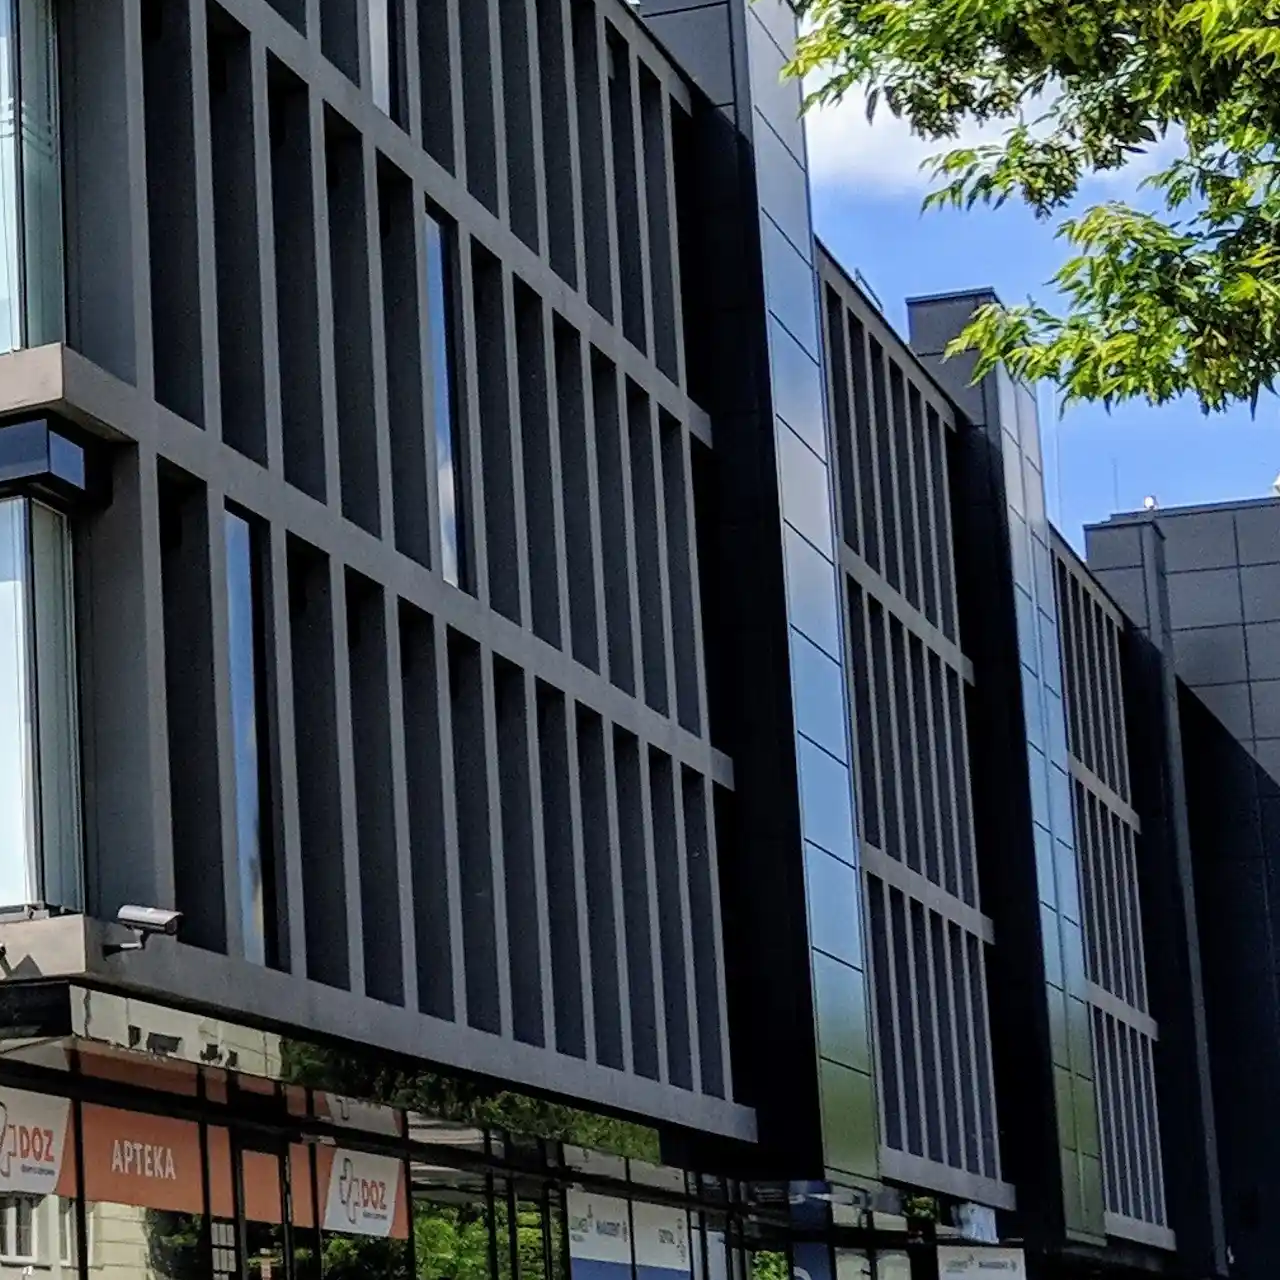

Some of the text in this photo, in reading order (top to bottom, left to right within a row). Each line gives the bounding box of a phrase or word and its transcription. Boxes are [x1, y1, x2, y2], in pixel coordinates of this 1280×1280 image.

[19, 1125, 54, 1162] DOZ
[111, 1139, 177, 1180] APTEKA
[361, 1178, 387, 1210] DOZ
